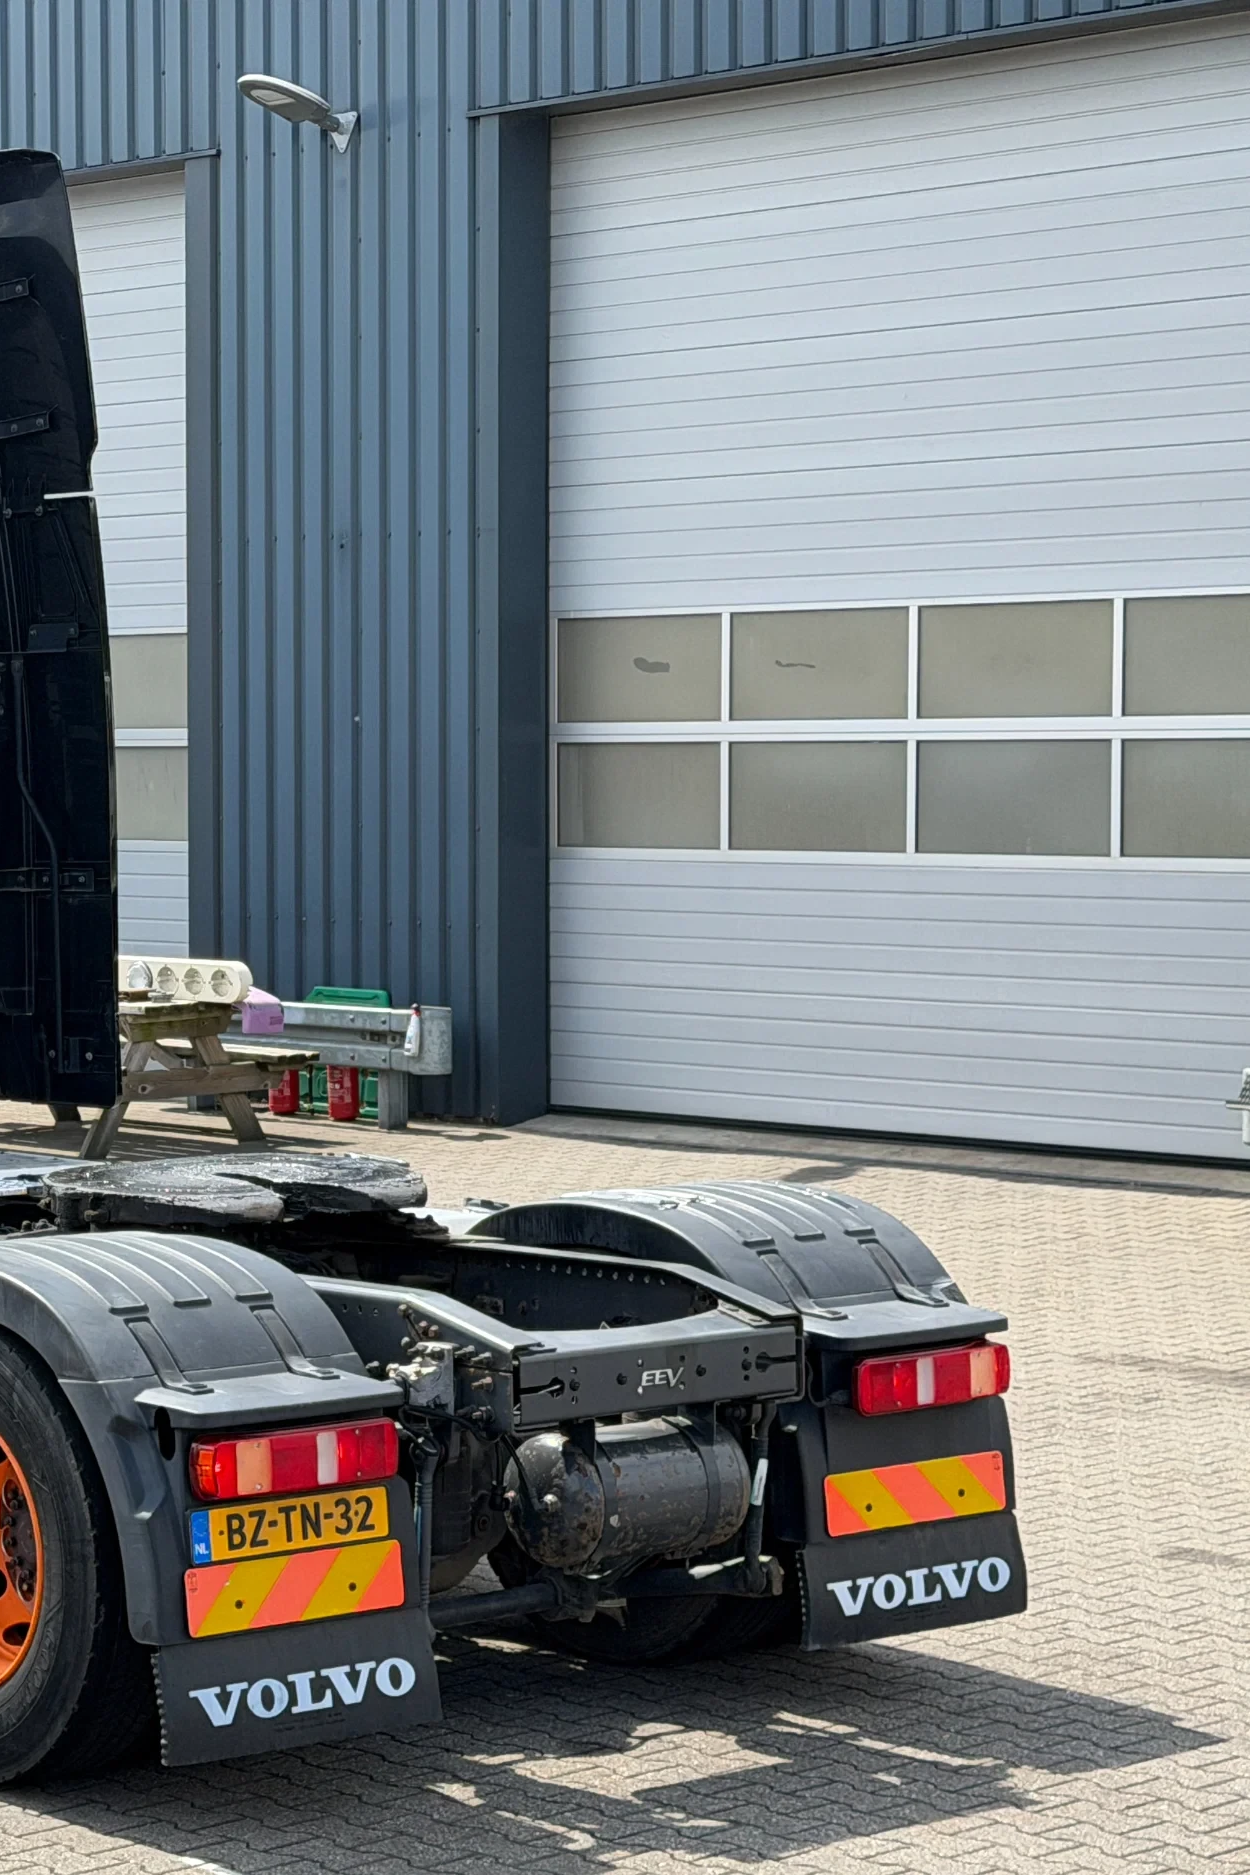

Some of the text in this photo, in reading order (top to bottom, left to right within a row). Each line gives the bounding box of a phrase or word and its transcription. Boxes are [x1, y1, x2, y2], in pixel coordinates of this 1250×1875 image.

[641, 1367, 685, 1387] EEV
[194, 1542, 210, 1557] NL
[225, 1495, 377, 1551] BZ-TN-32
[826, 1556, 1011, 1617] VOLVO
[188, 1657, 416, 1728] VOLVO
